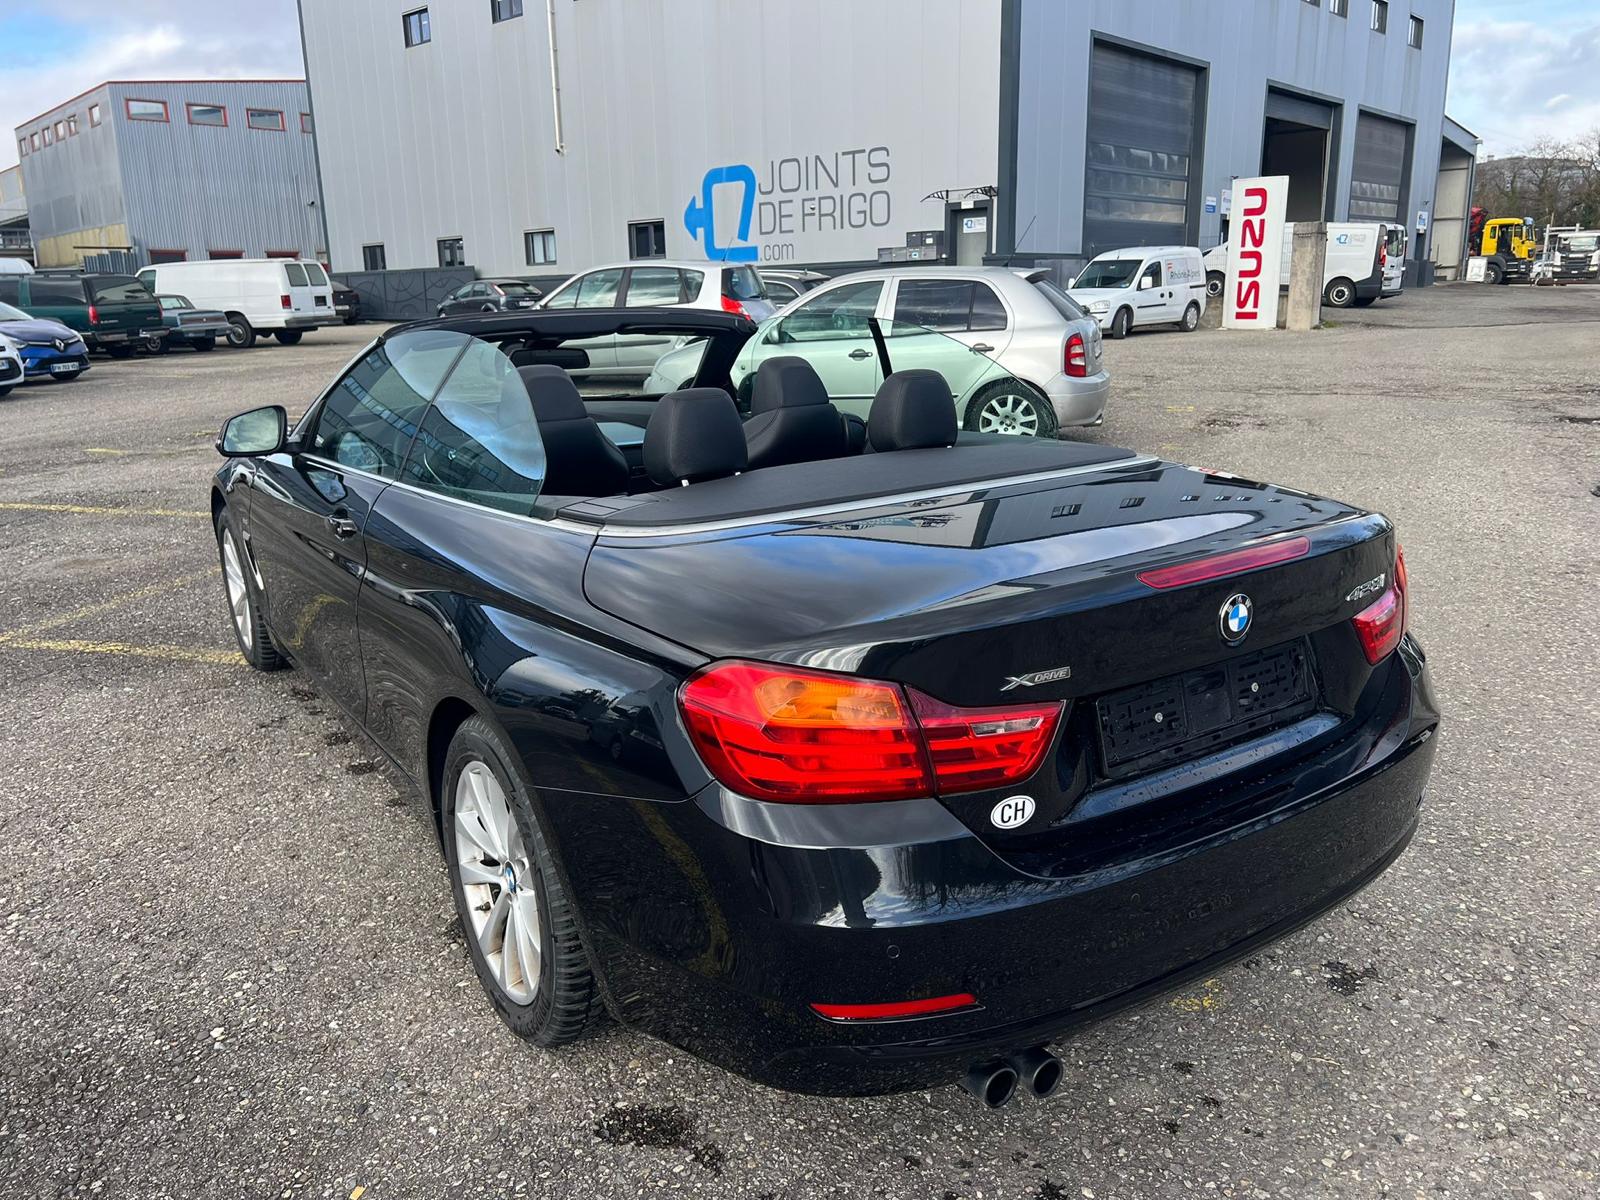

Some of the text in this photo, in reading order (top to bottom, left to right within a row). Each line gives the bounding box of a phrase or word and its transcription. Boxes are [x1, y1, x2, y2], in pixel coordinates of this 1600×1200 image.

[758, 146, 890, 195] JOINTS
[758, 190, 891, 235] DE FRIGO
[760, 243, 795, 261] .com
[1235, 187, 1268, 320] ISUZU
[1000, 801, 1026, 824] CH
